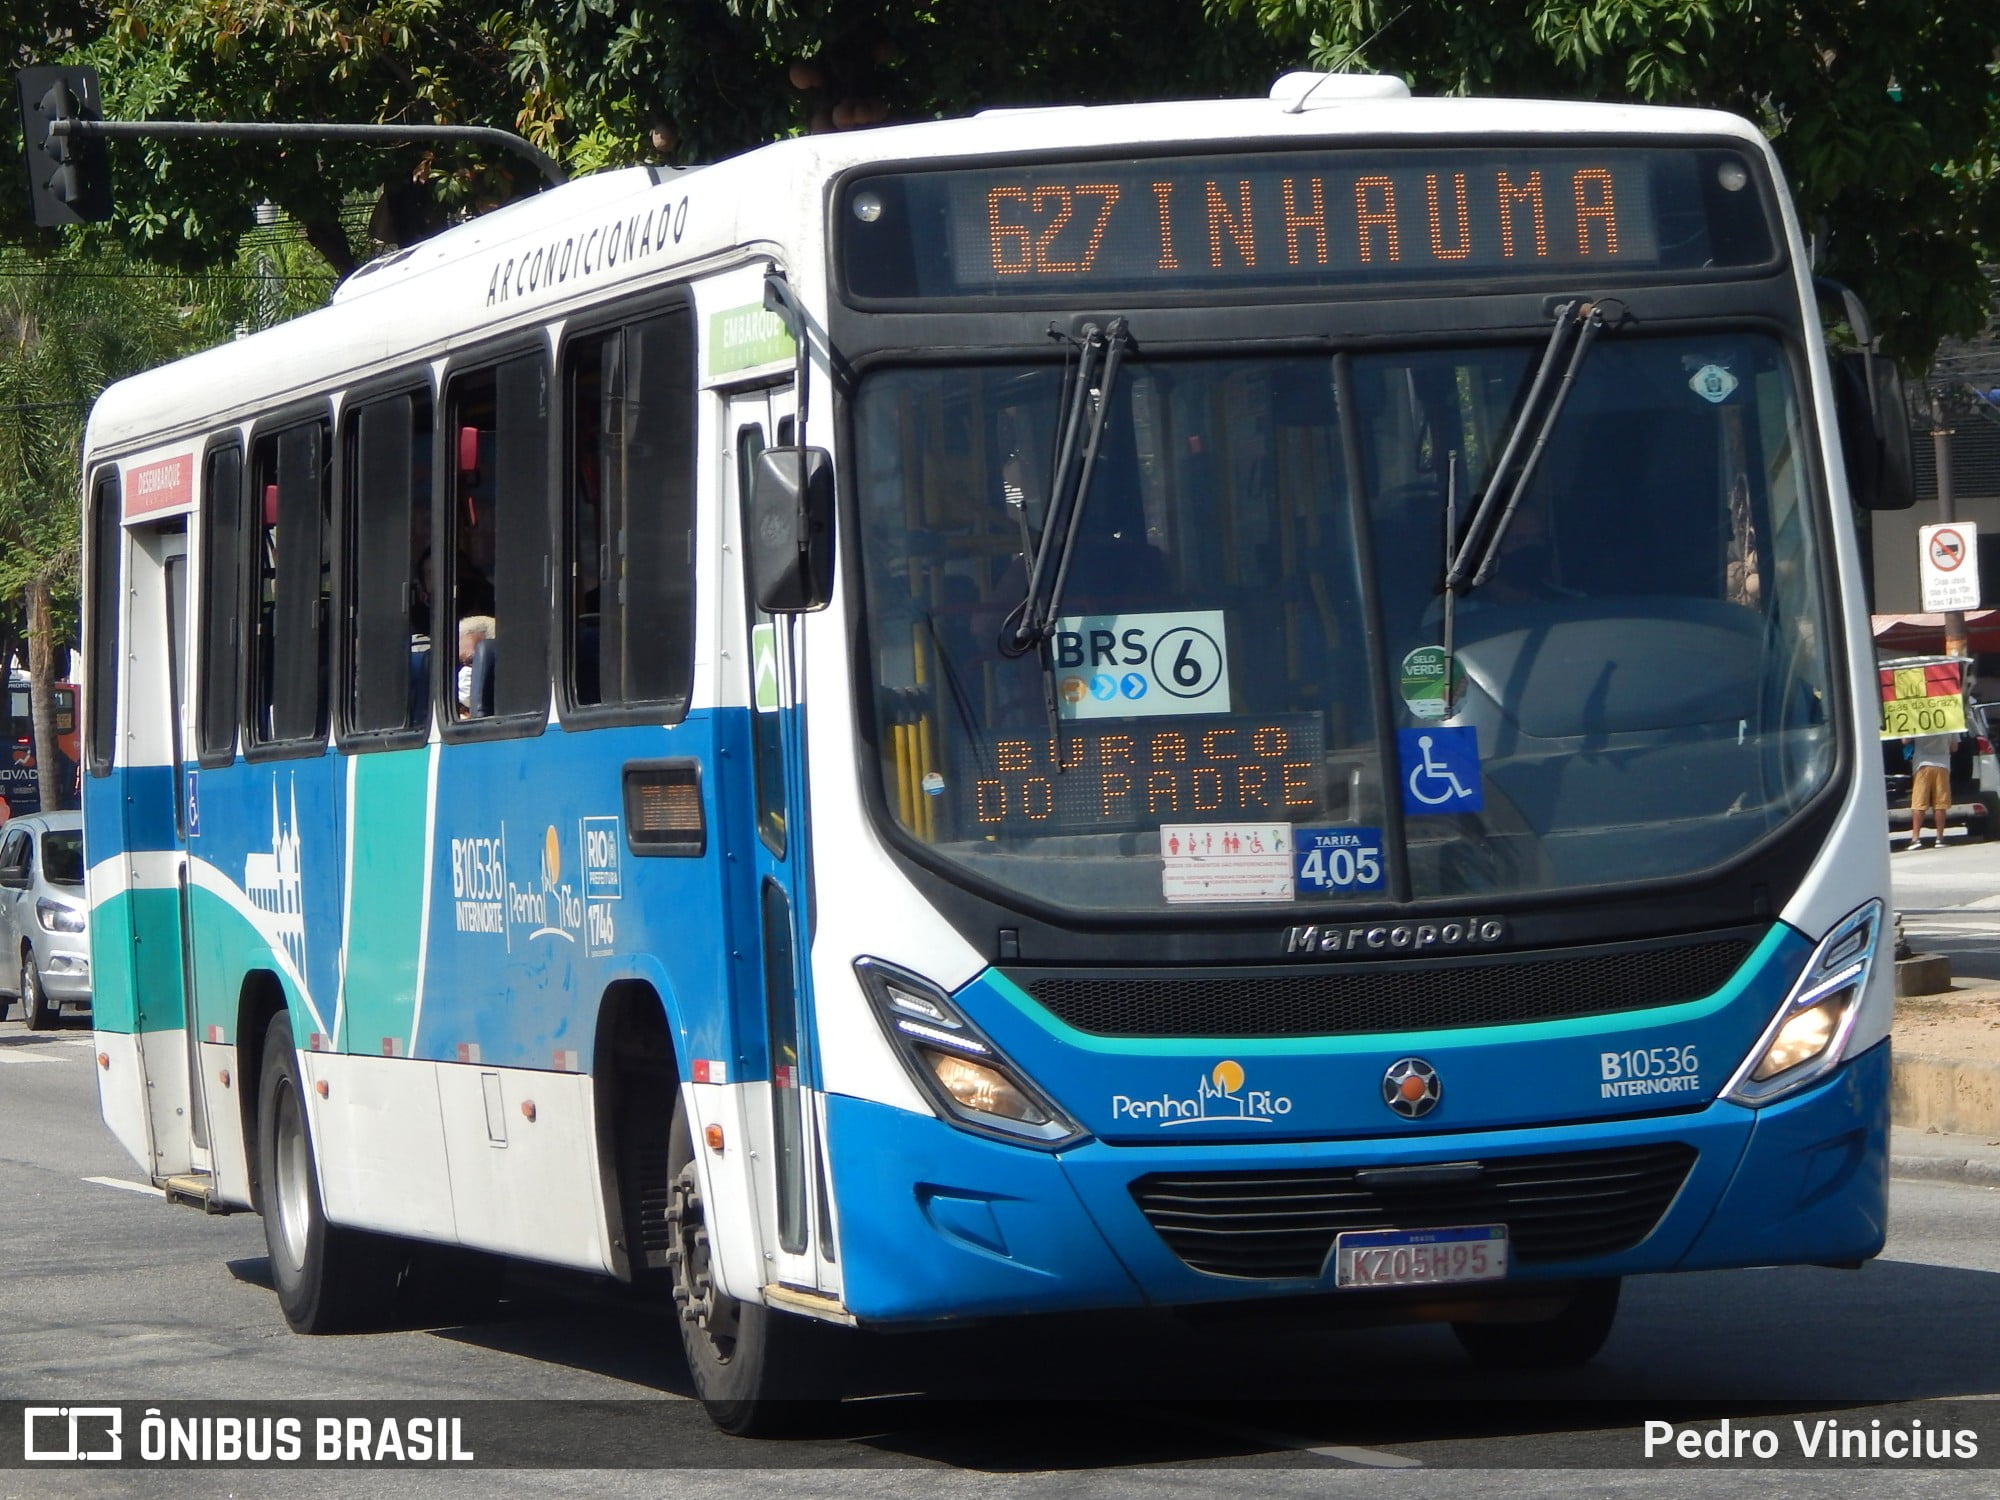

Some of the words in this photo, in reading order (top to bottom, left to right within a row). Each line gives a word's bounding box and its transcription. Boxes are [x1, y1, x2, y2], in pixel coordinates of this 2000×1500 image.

[987, 183, 1120, 274] 627
[1152, 168, 1618, 269] INHAUMA
[723, 310, 779, 349] EMBARQUE
[138, 462, 180, 495] DESEMBARQUE
[1056, 628, 1148, 669] BRS
[1173, 639, 1202, 687] 6
[1404, 663, 1444, 676] VERDE
[1412, 654, 1437, 664] SELO
[998, 726, 1288, 772] BURACO
[976, 775, 1053, 822] DO
[1101, 762, 1314, 816] PADRE
[587, 830, 608, 868] RIO
[1314, 835, 1361, 847] TARIFA
[451, 838, 503, 900] B10536
[1301, 847, 1381, 889] 4,05
[455, 901, 504, 934] INTERNORTE
[587, 902, 614, 946] 1746
[1287, 917, 1503, 954] Marcopolo
[1600, 1044, 1699, 1080] B10536
[1113, 1093, 1199, 1119] Penha
[1248, 1090, 1293, 1116] Rio
[1600, 1074, 1700, 1099] INTERNORTE
